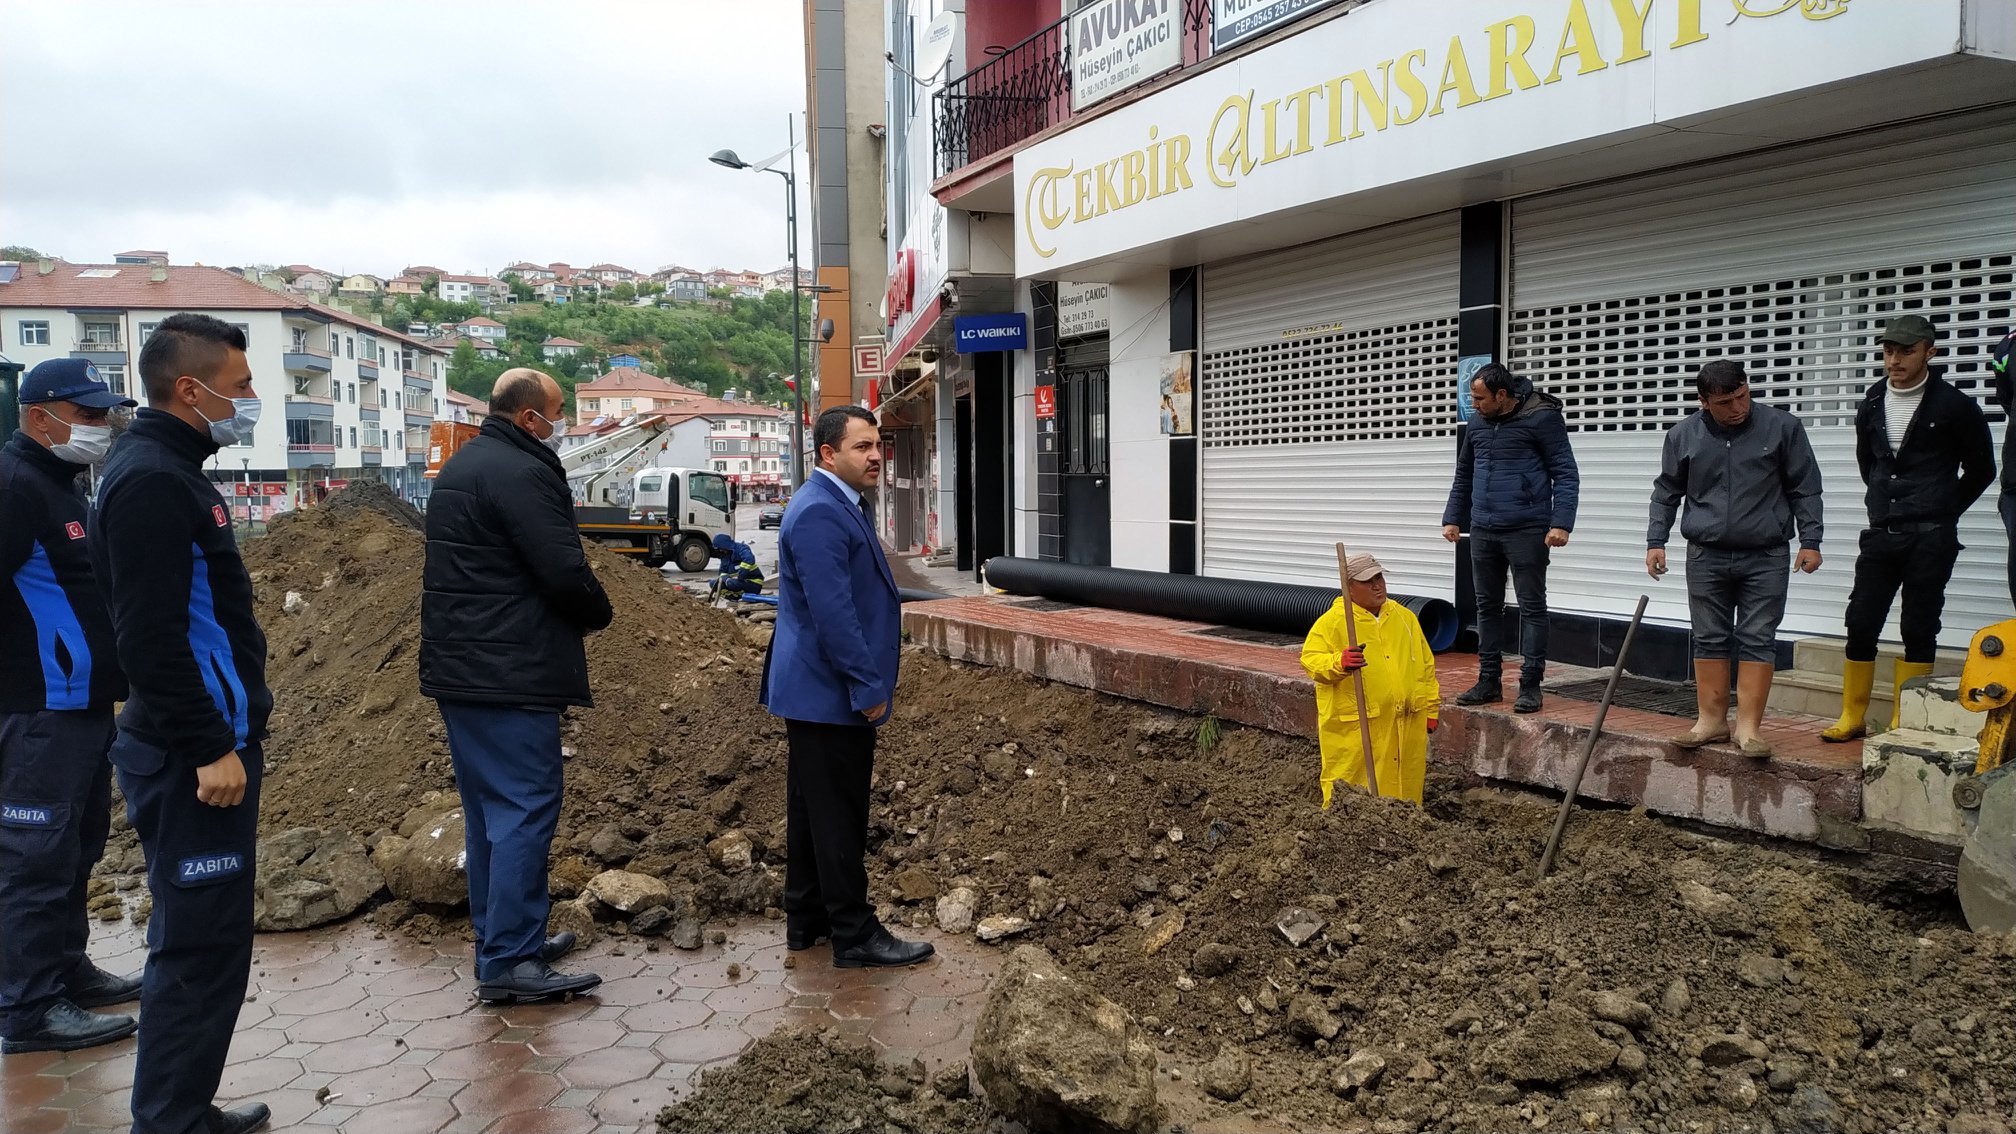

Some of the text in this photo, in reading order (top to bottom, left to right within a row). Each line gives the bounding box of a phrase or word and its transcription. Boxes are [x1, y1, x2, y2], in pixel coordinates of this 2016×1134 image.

[1274, 0, 1290, 17] 257
[1080, 47, 1123, 81] Hüseyin
[1126, 19, 1170, 63] ÇAKICI
[1025, 125, 1193, 258] TEKBİR
[1085, 286, 1108, 305] ÇAKICI
[961, 329, 976, 339] LC
[861, 352, 878, 369] E
[3, 806, 46, 822] ZABITA
[184, 856, 239, 876] ZABITA
